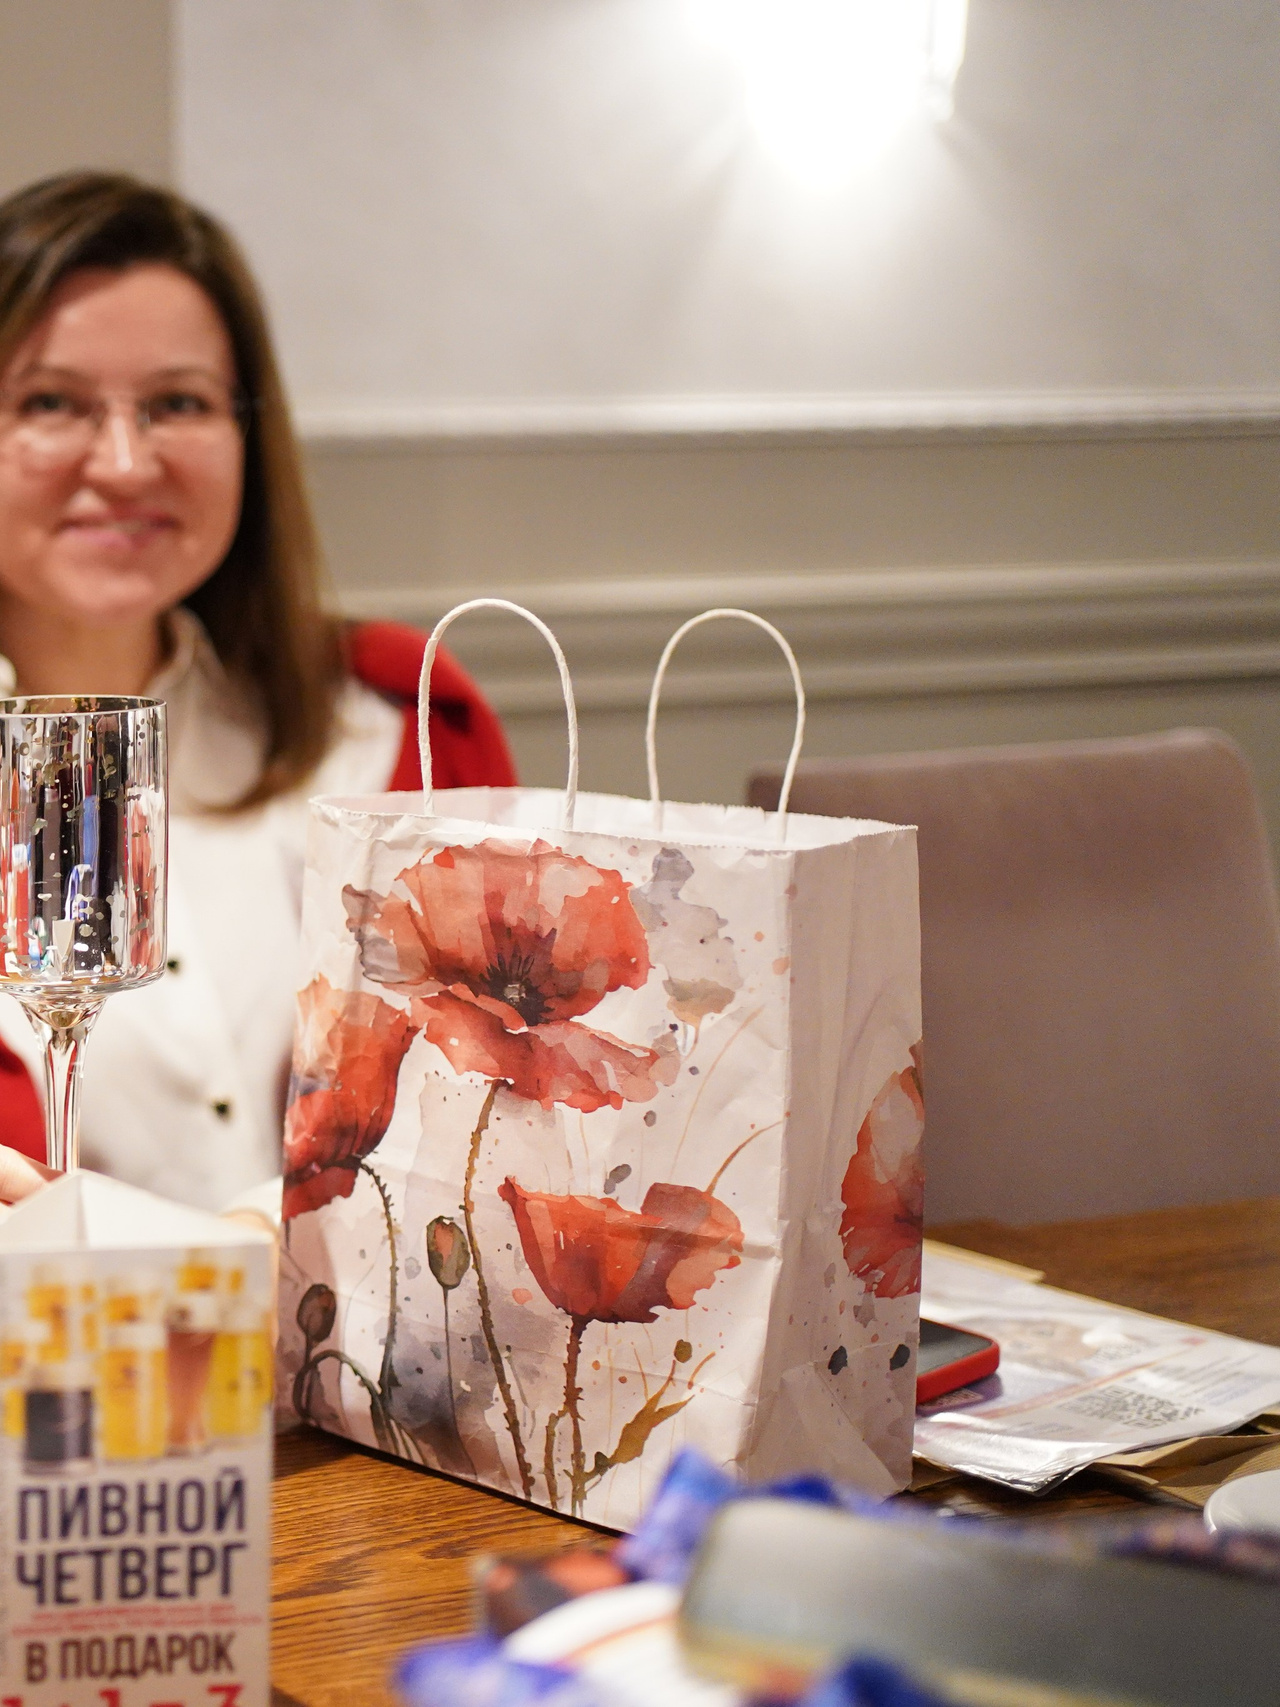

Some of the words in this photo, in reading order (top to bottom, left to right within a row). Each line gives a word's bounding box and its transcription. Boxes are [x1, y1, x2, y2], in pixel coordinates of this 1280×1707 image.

[17, 1465, 246, 1542] ПИВНОЙ
[15, 1542, 248, 1605] ЧЕТВЕРГ
[25, 1640, 48, 1684] В
[60, 1630, 236, 1681] ПОДАРОК
